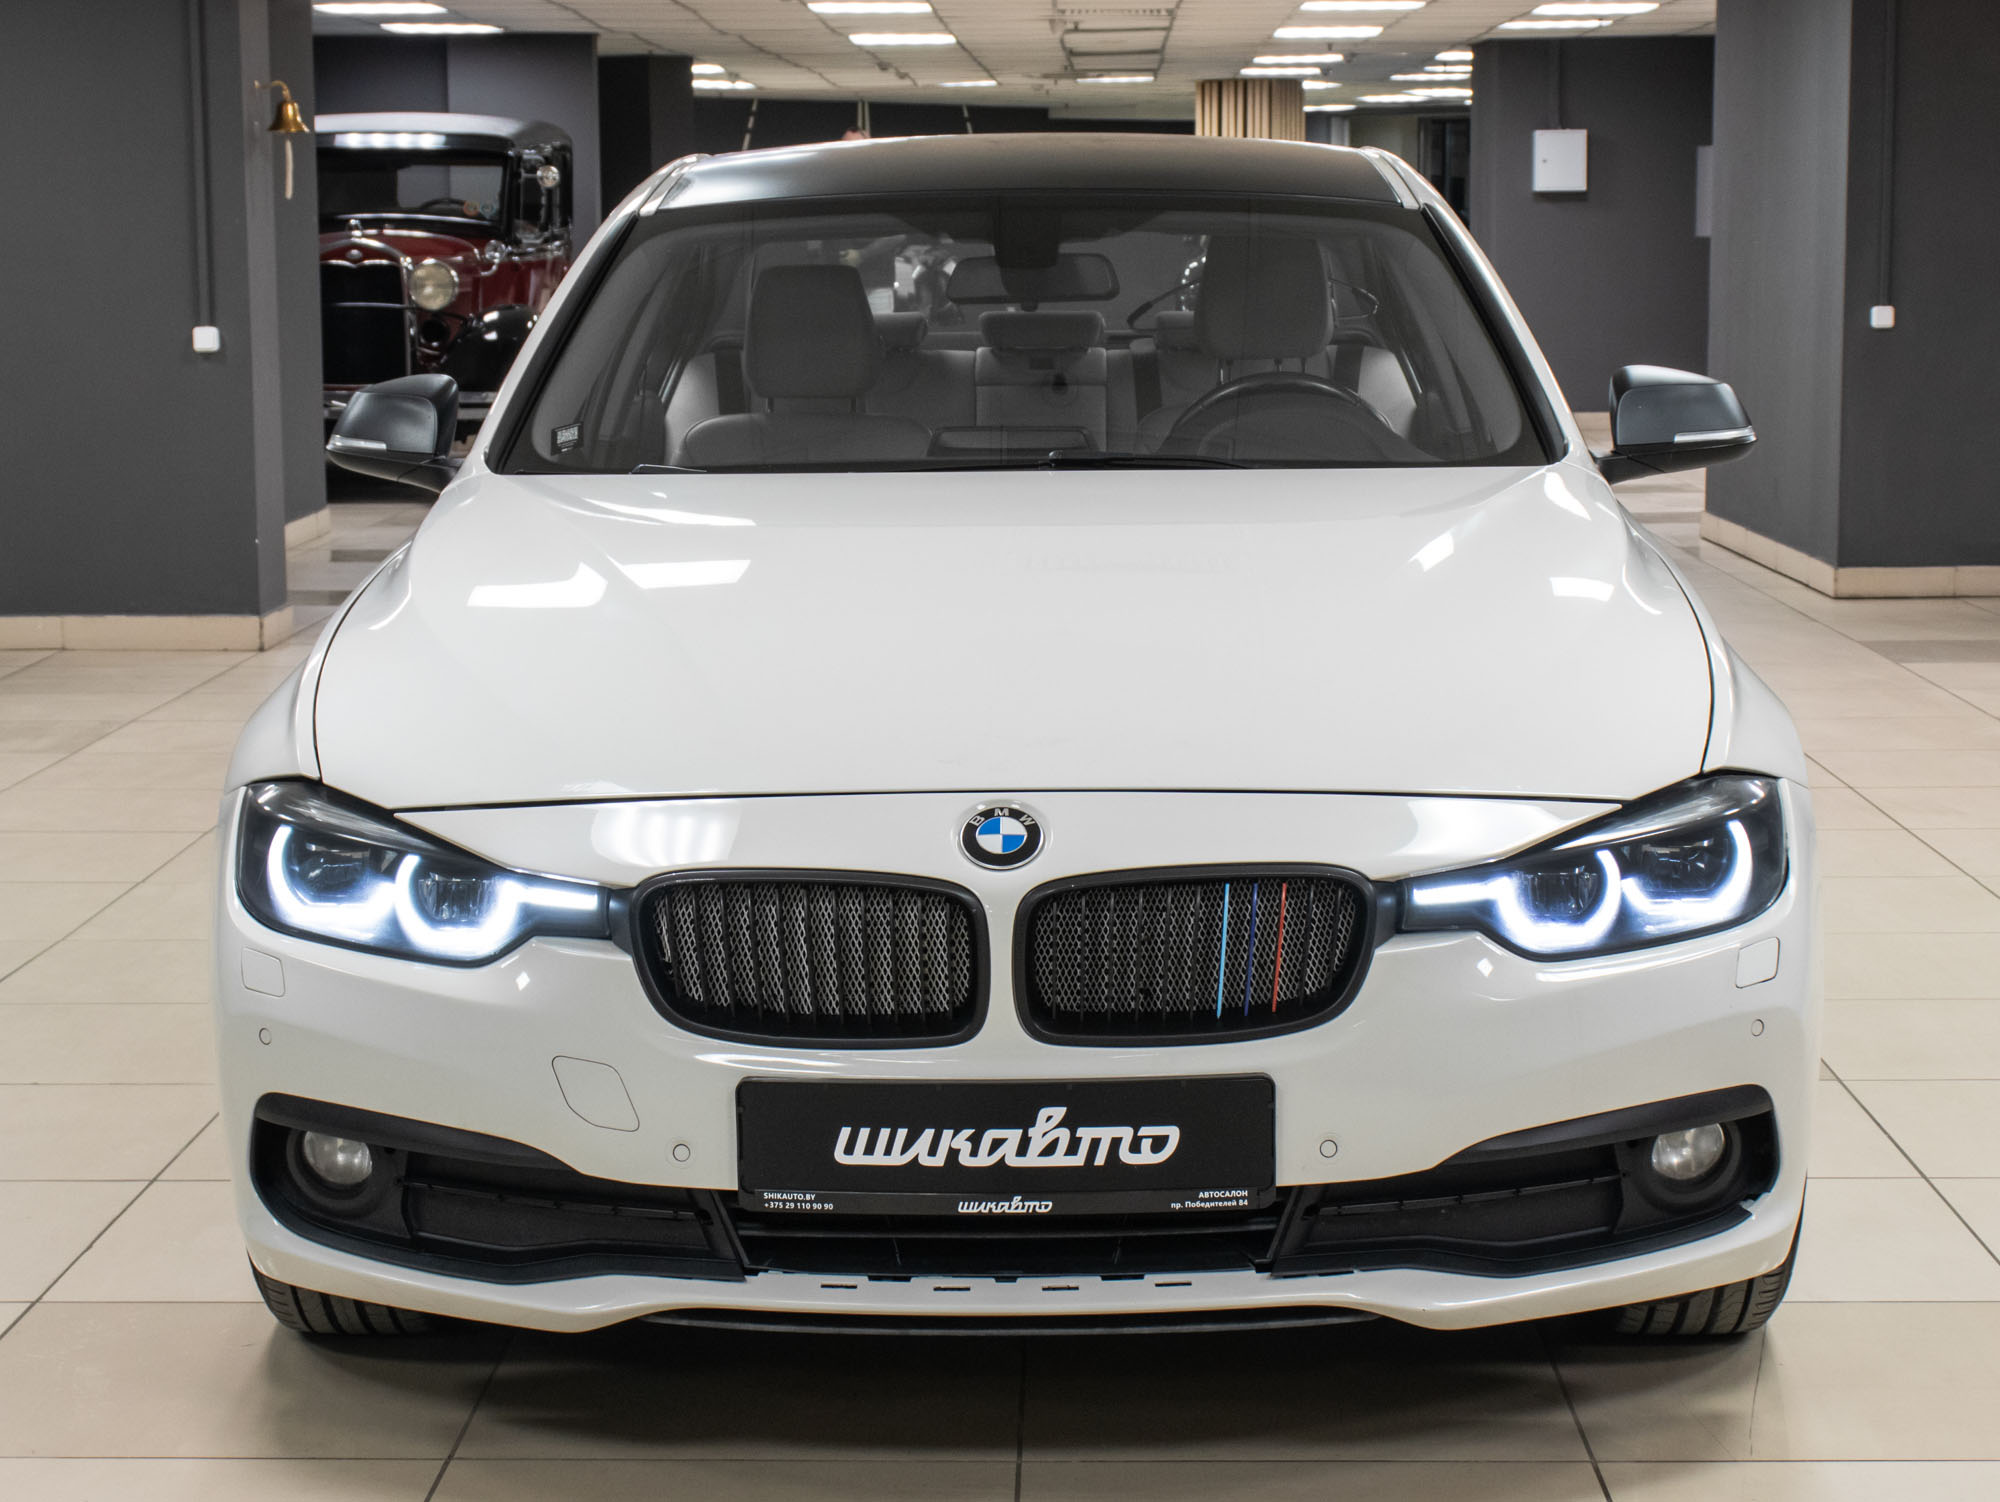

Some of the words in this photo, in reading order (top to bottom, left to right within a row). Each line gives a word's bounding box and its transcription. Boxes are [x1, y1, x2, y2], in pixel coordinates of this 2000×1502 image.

[969, 807, 1035, 826] BMW
[763, 1192, 816, 1200] SHIKAUTO.BY
[1198, 1190, 1248, 1199] АВТОСАЛОН
[764, 1201, 784, 1209] +375
[812, 1202, 822, 1210] 90
[1170, 1202, 1183, 1210] пр.
[1185, 1200, 1237, 1209] Победителей
